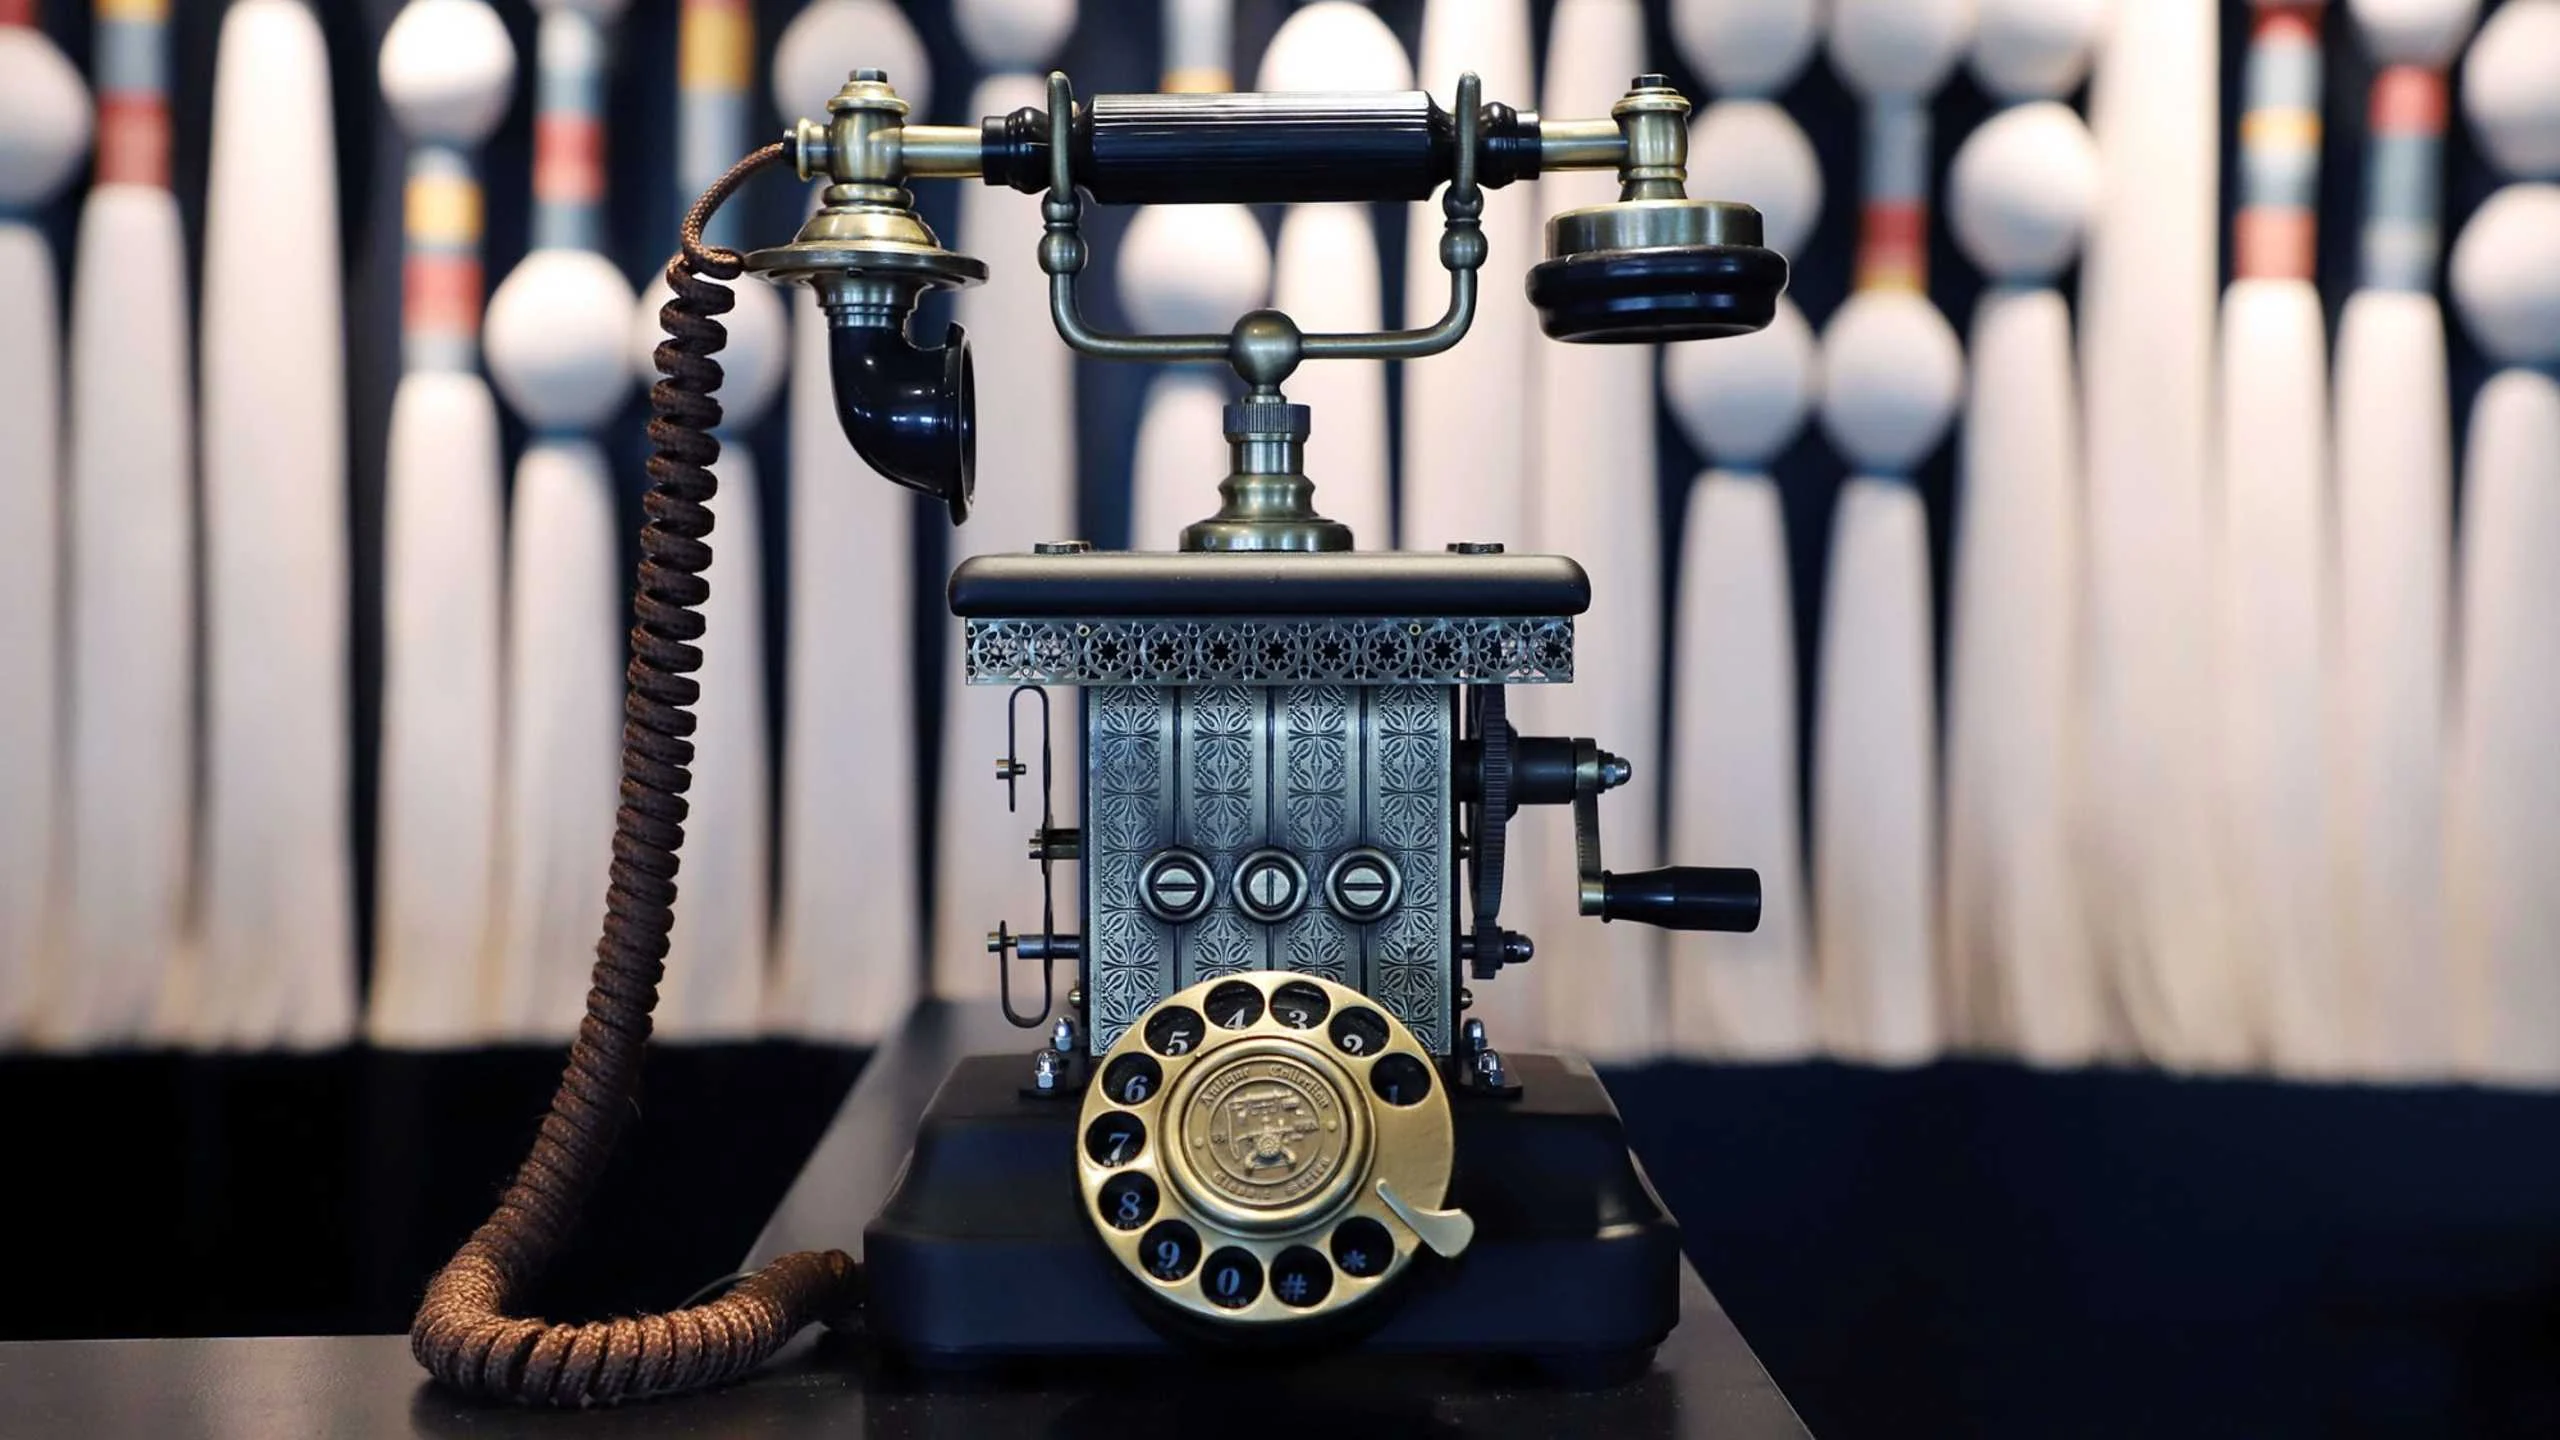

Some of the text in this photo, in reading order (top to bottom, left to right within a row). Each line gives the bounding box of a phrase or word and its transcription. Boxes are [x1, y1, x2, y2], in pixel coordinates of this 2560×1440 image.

[1224, 1009, 1245, 1030] 4
[1289, 1010, 1308, 1030] 3
[1166, 1031, 1190, 1056] 5
[1343, 1034, 1363, 1056] 2
[1124, 1075, 1148, 1103] 6
[1201, 1065, 1329, 1108] Antique Collection
[1388, 1085, 1399, 1104] 1
[1109, 1133, 1130, 1161] 7
[1118, 1192, 1140, 1221] 8
[1158, 1241, 1180, 1269] 9
[1217, 1268, 1240, 1296] 0
[1279, 1273, 1307, 1300] #
